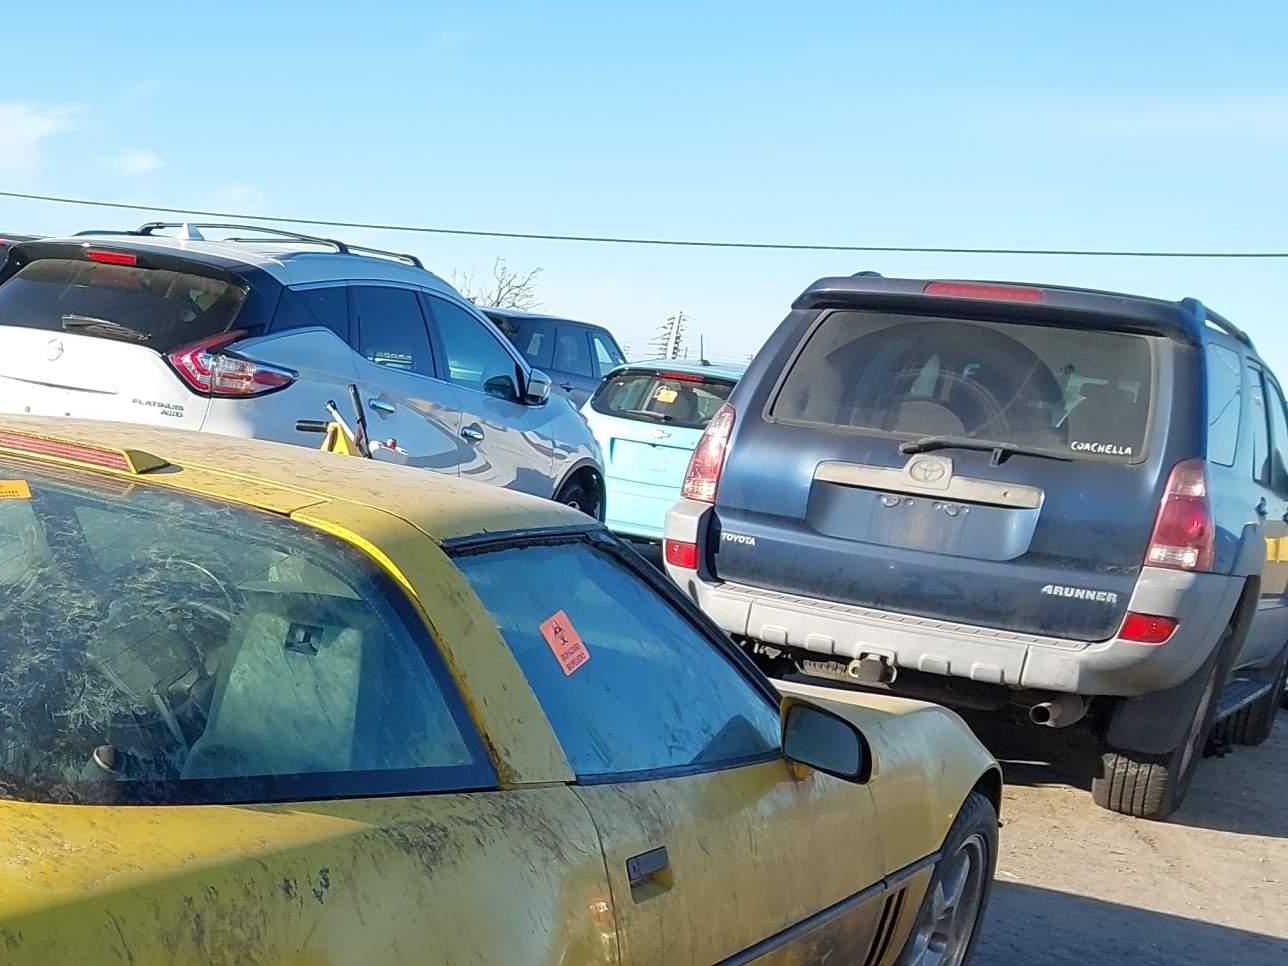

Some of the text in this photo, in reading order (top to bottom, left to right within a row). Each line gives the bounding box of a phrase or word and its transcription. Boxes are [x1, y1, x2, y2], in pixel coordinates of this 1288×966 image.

[1070, 441, 1132, 455] COACHELLA
[722, 532, 756, 546] TOYOTA
[1041, 584, 1118, 603] 4RUNNER
